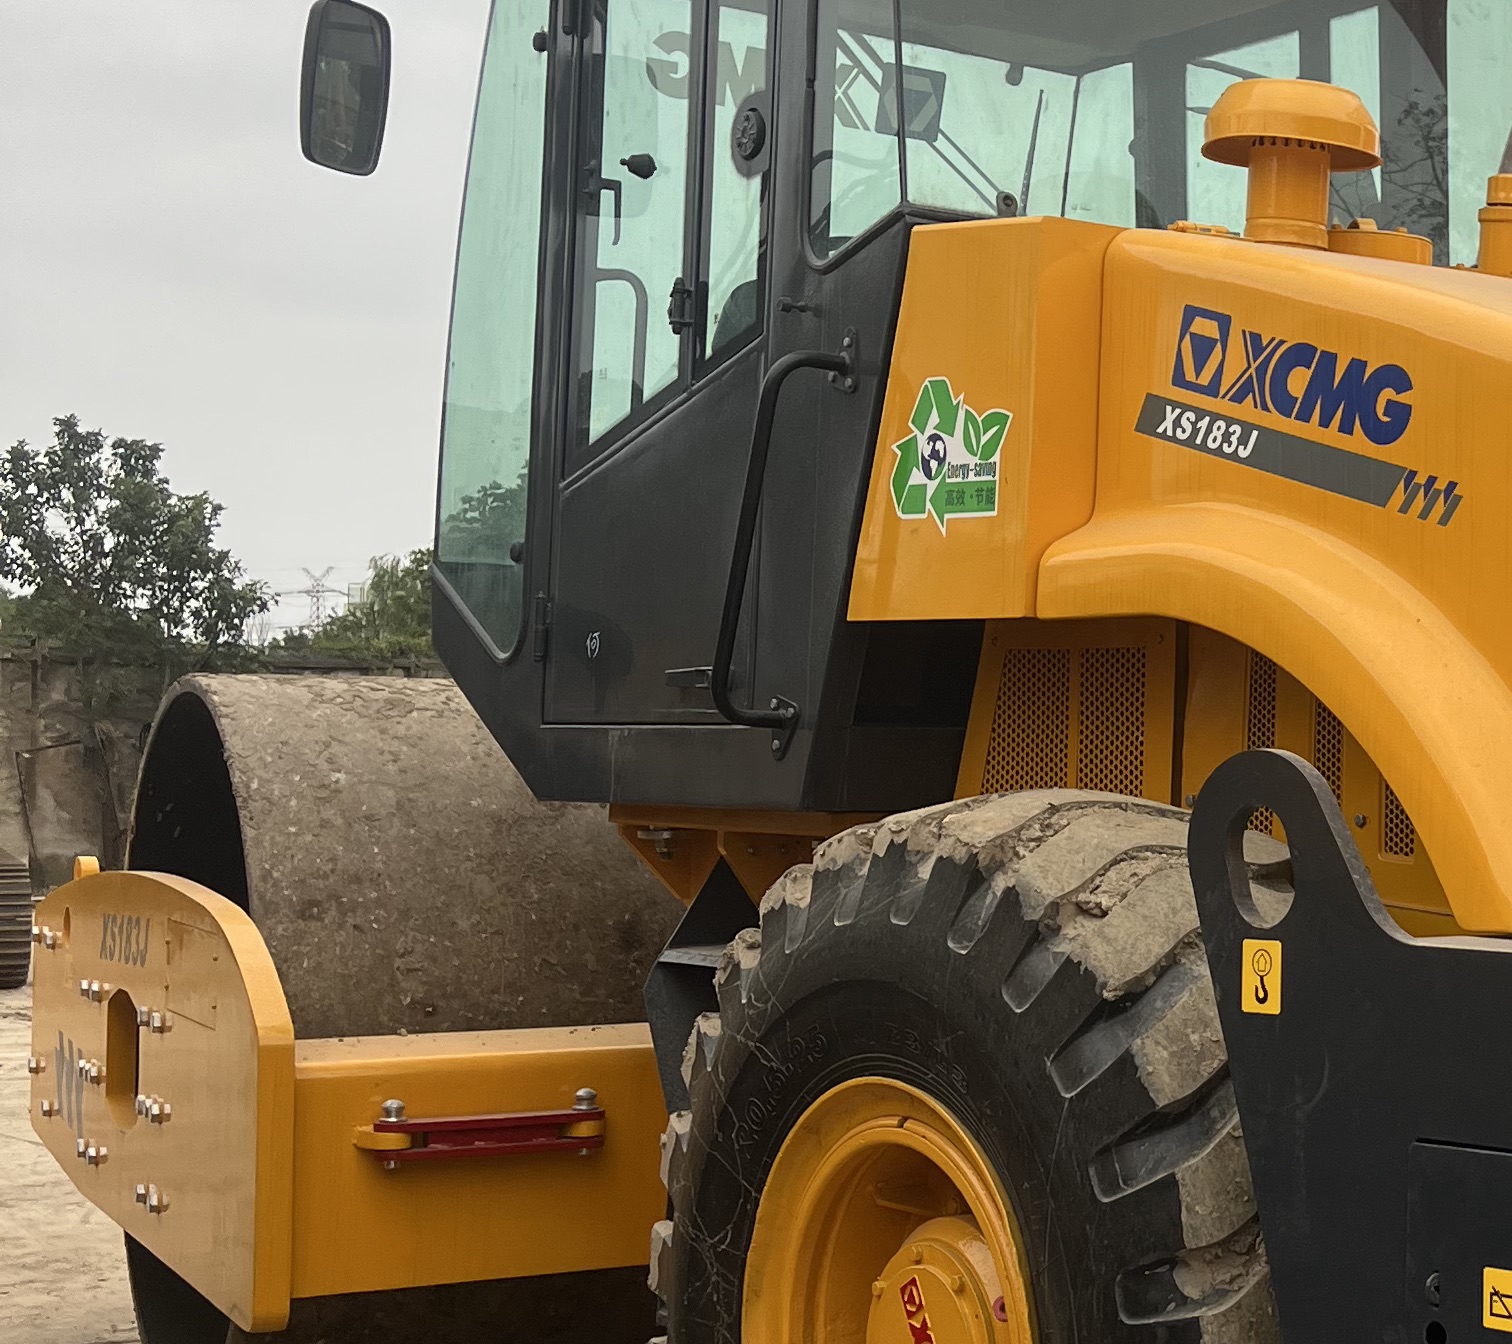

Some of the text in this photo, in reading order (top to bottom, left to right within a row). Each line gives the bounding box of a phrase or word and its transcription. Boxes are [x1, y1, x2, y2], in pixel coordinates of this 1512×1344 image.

[1219, 328, 1414, 446] XCMG
[1156, 404, 1259, 459] XS183J
[100, 913, 151, 968] XS183J
